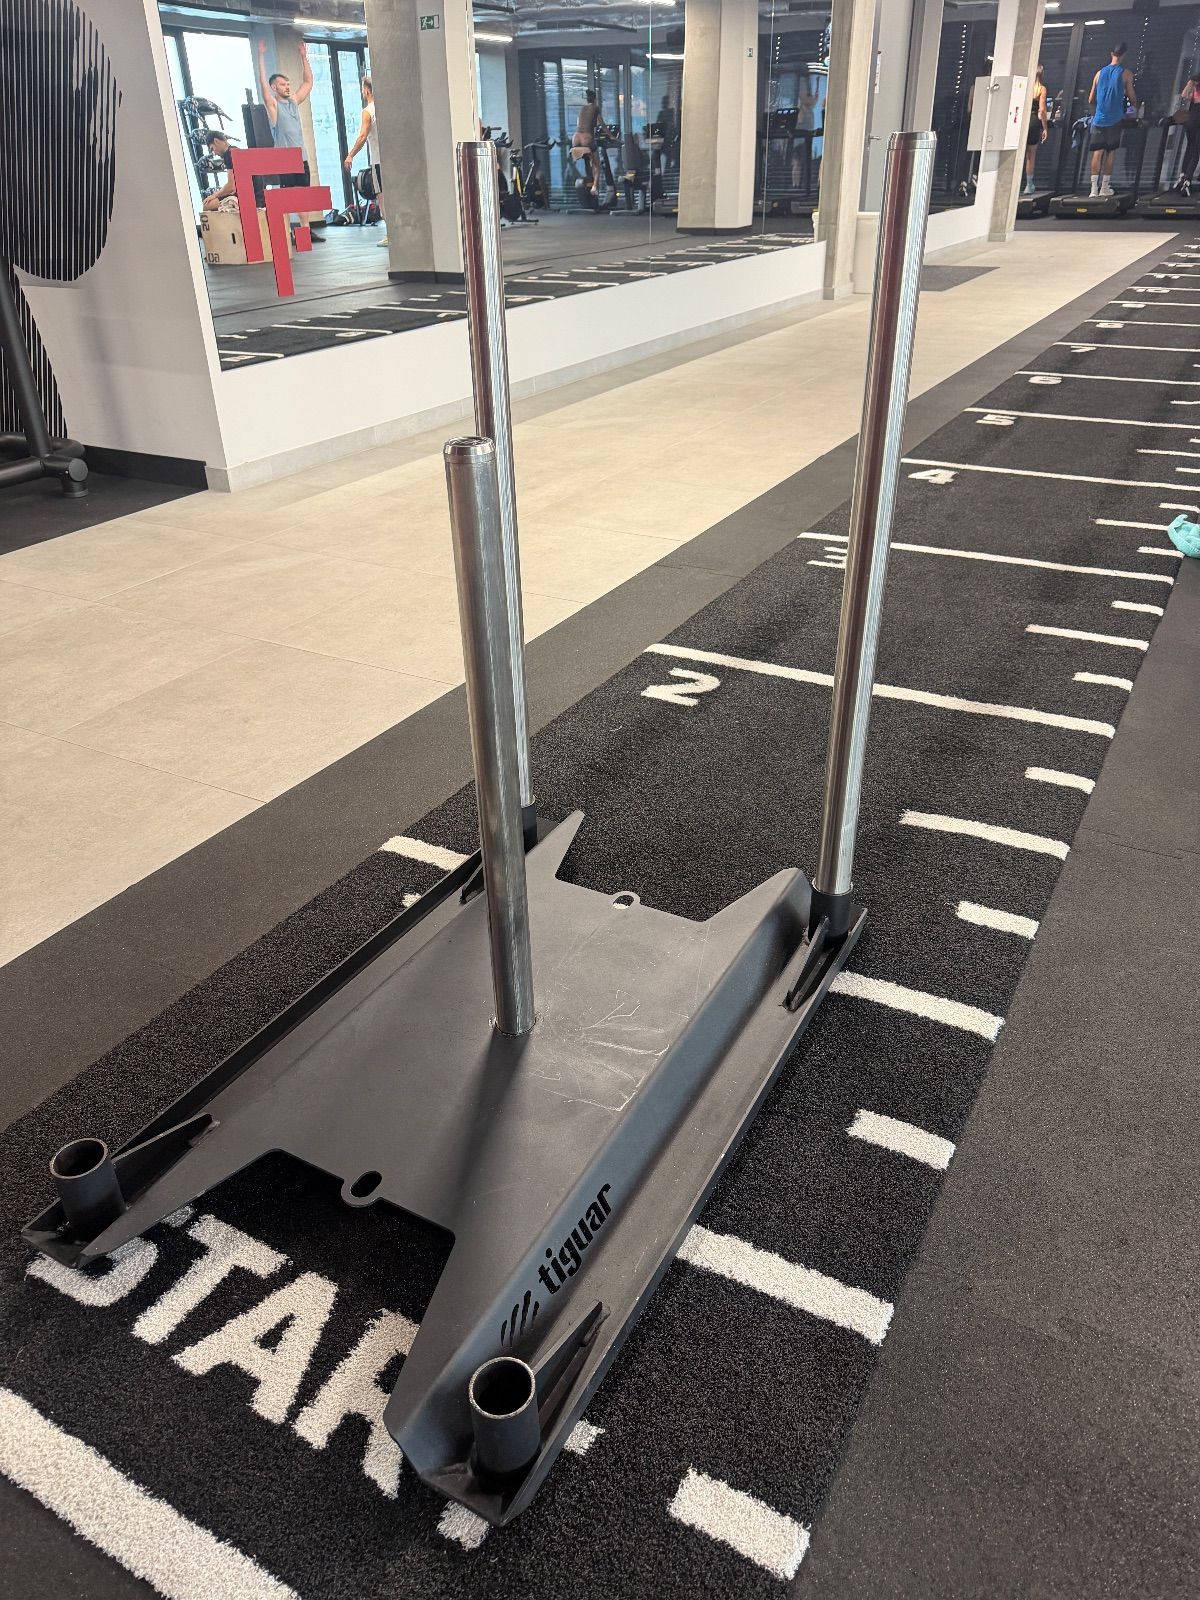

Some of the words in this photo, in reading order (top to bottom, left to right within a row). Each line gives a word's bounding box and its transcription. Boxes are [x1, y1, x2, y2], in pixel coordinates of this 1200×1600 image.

[1028, 375, 1063, 385] 6
[976, 413, 1018, 426] 5
[907, 468, 960, 485] 4
[640, 667, 721, 707] 2
[538, 1183, 612, 1295] tiguar
